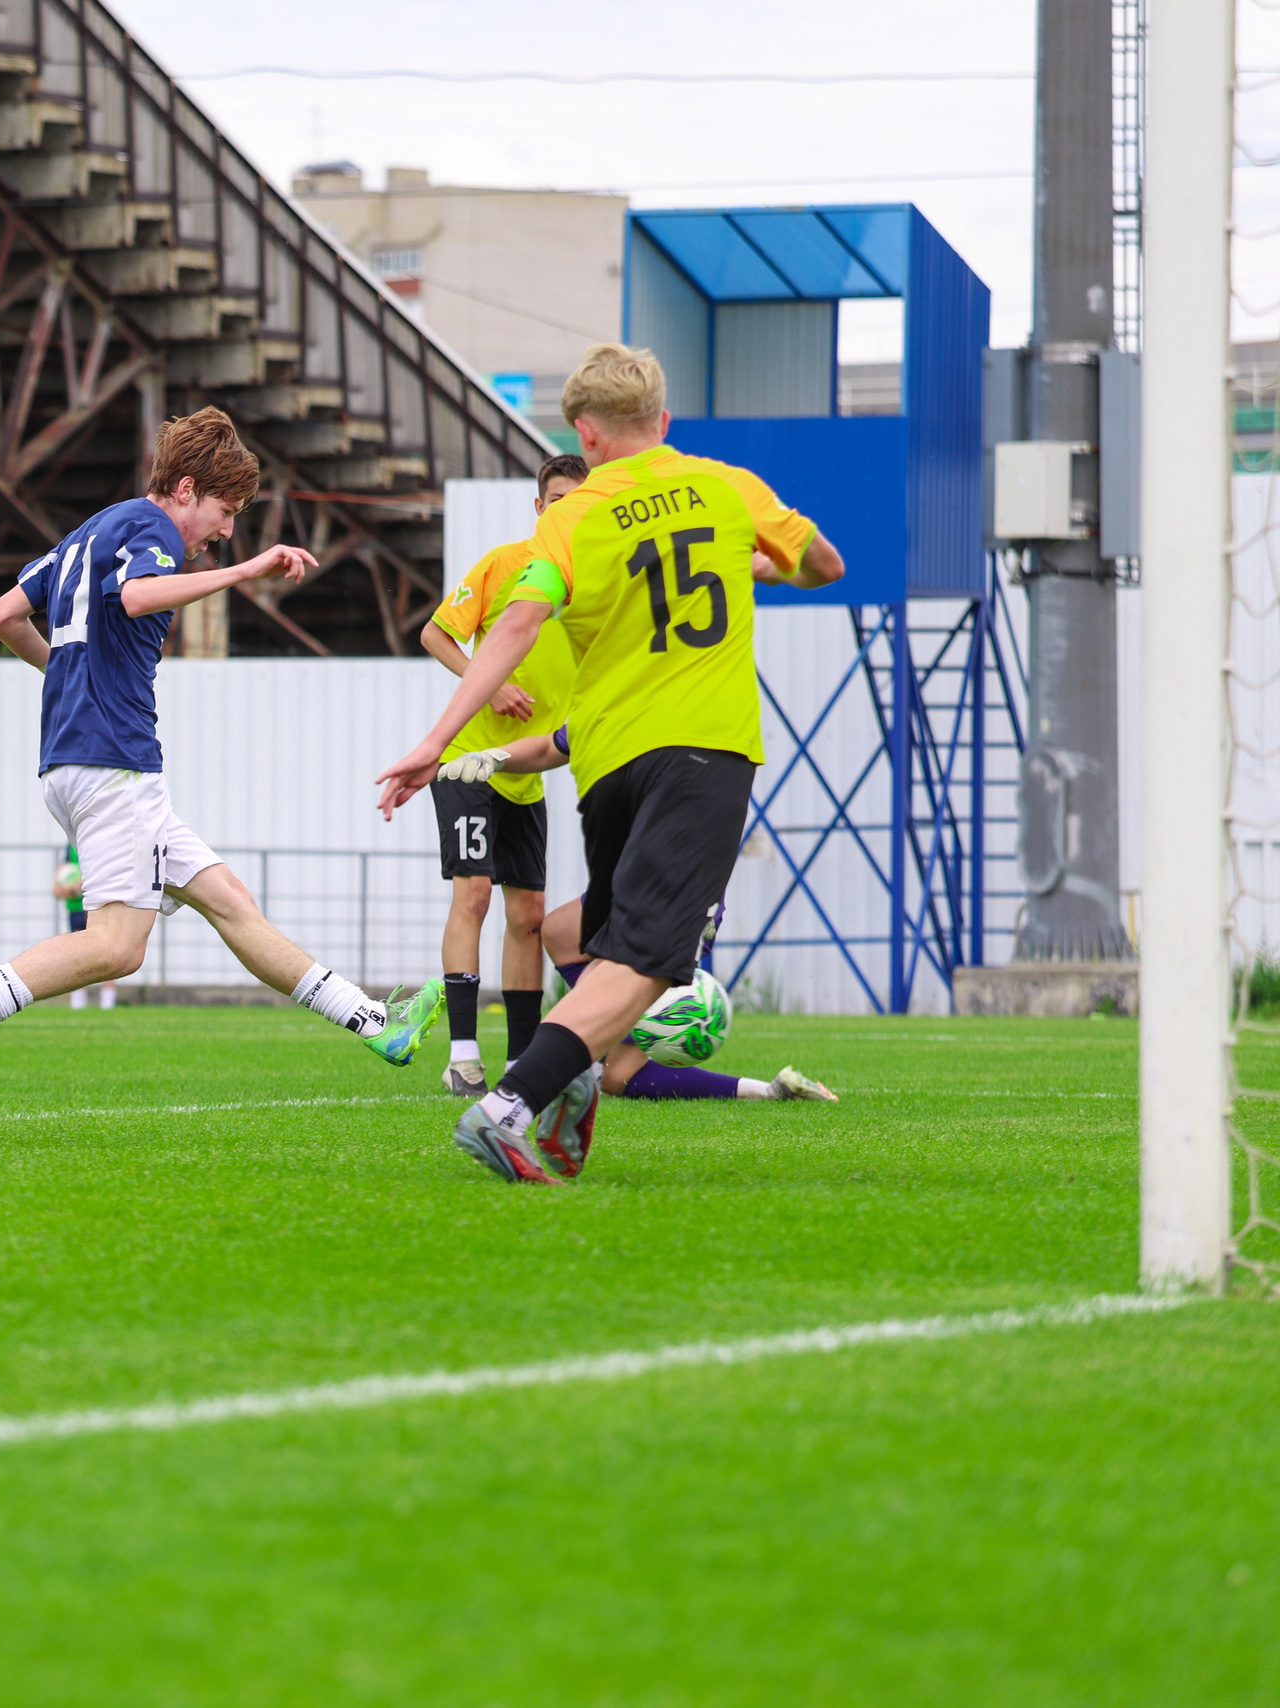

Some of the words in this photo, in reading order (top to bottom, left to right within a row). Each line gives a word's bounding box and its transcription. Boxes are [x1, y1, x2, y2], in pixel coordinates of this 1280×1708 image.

[611, 486, 706, 530] ВОЛГА
[626, 527, 729, 653] 15
[454, 815, 488, 860] 13
[152, 844, 168, 891] 1
